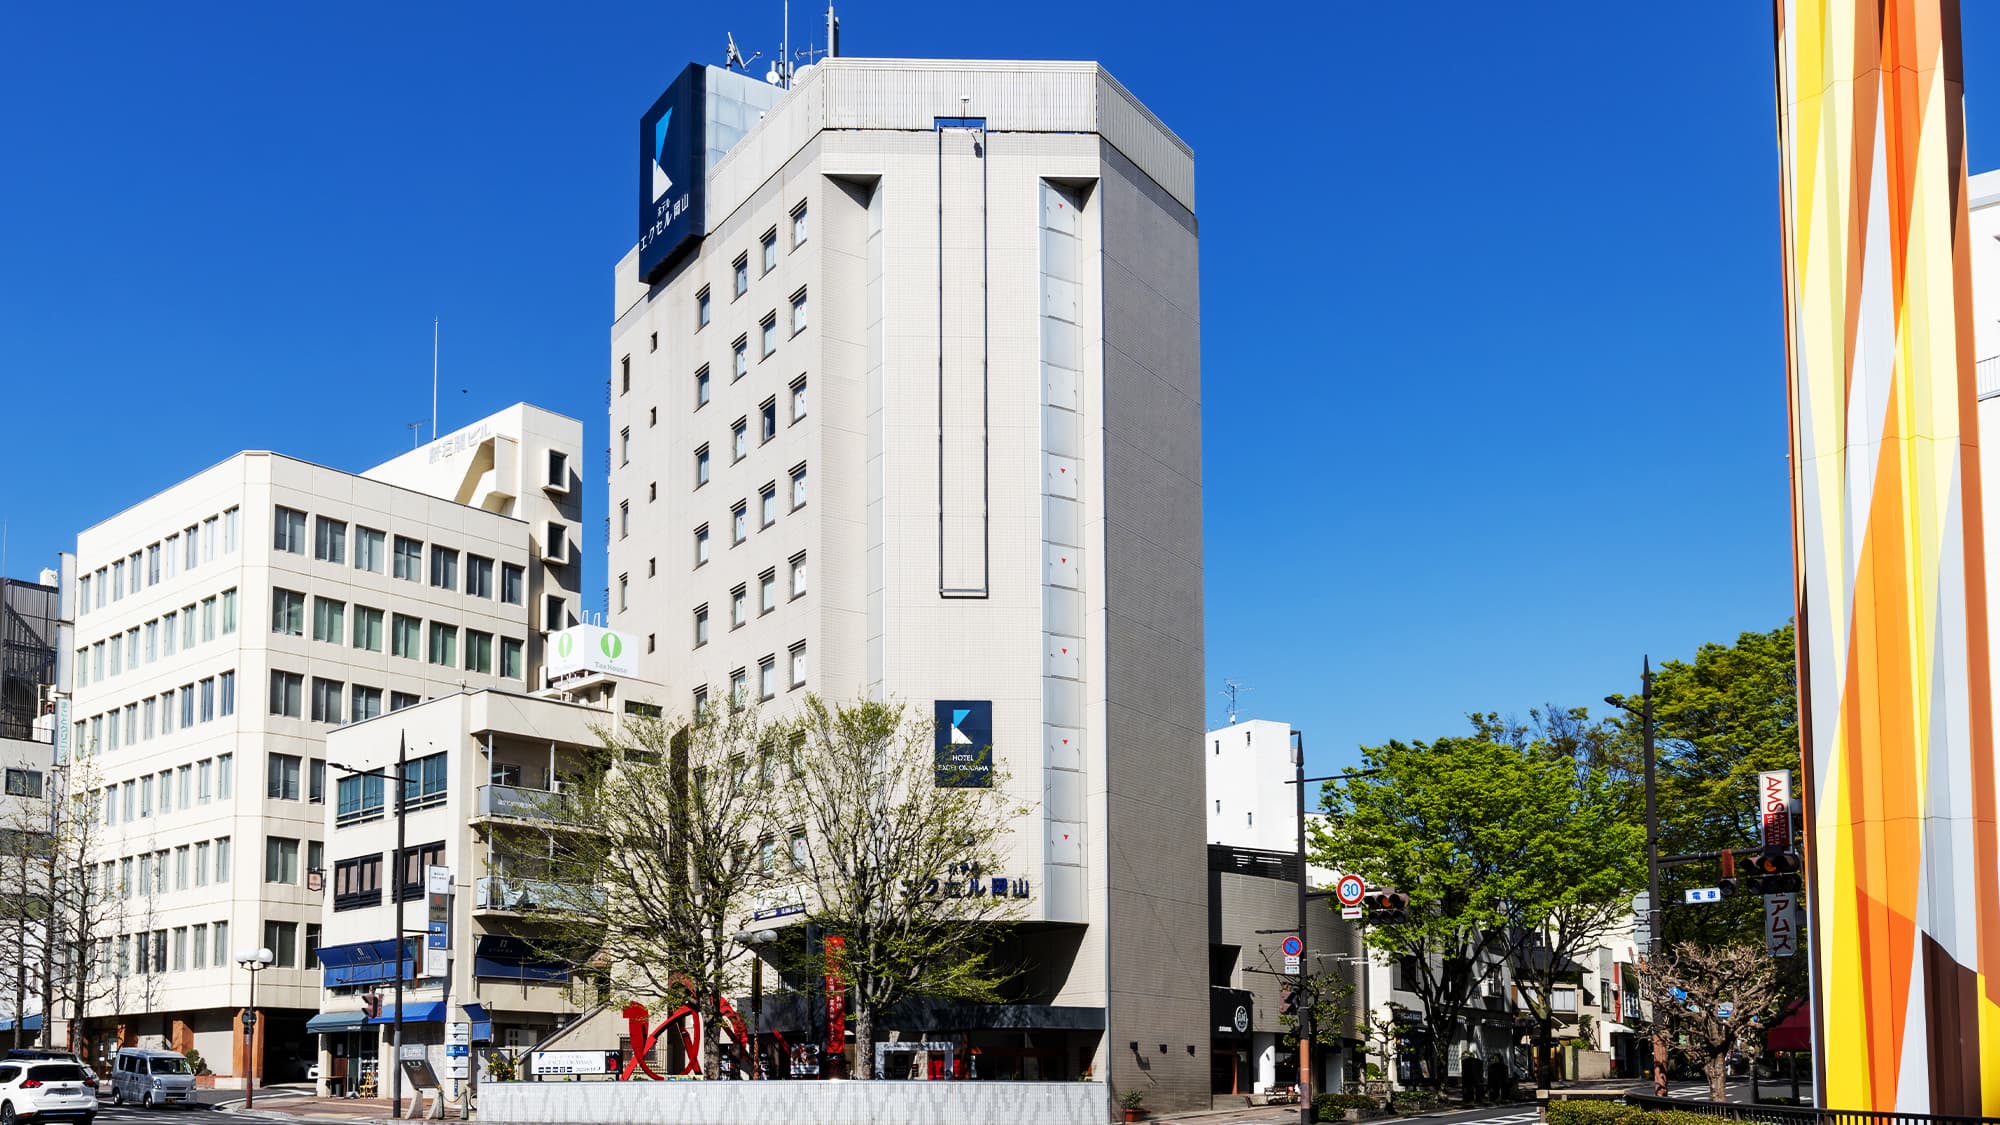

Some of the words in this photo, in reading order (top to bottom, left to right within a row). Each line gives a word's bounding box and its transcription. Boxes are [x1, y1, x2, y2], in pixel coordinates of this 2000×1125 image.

[640, 193, 689, 252] エクセル岡山
[952, 754, 974, 762] HOTEL
[1765, 776, 1785, 813] AMS
[1343, 883, 1359, 897] 30
[1691, 890, 1717, 901] 電車
[1771, 899, 1791, 951] アムス
